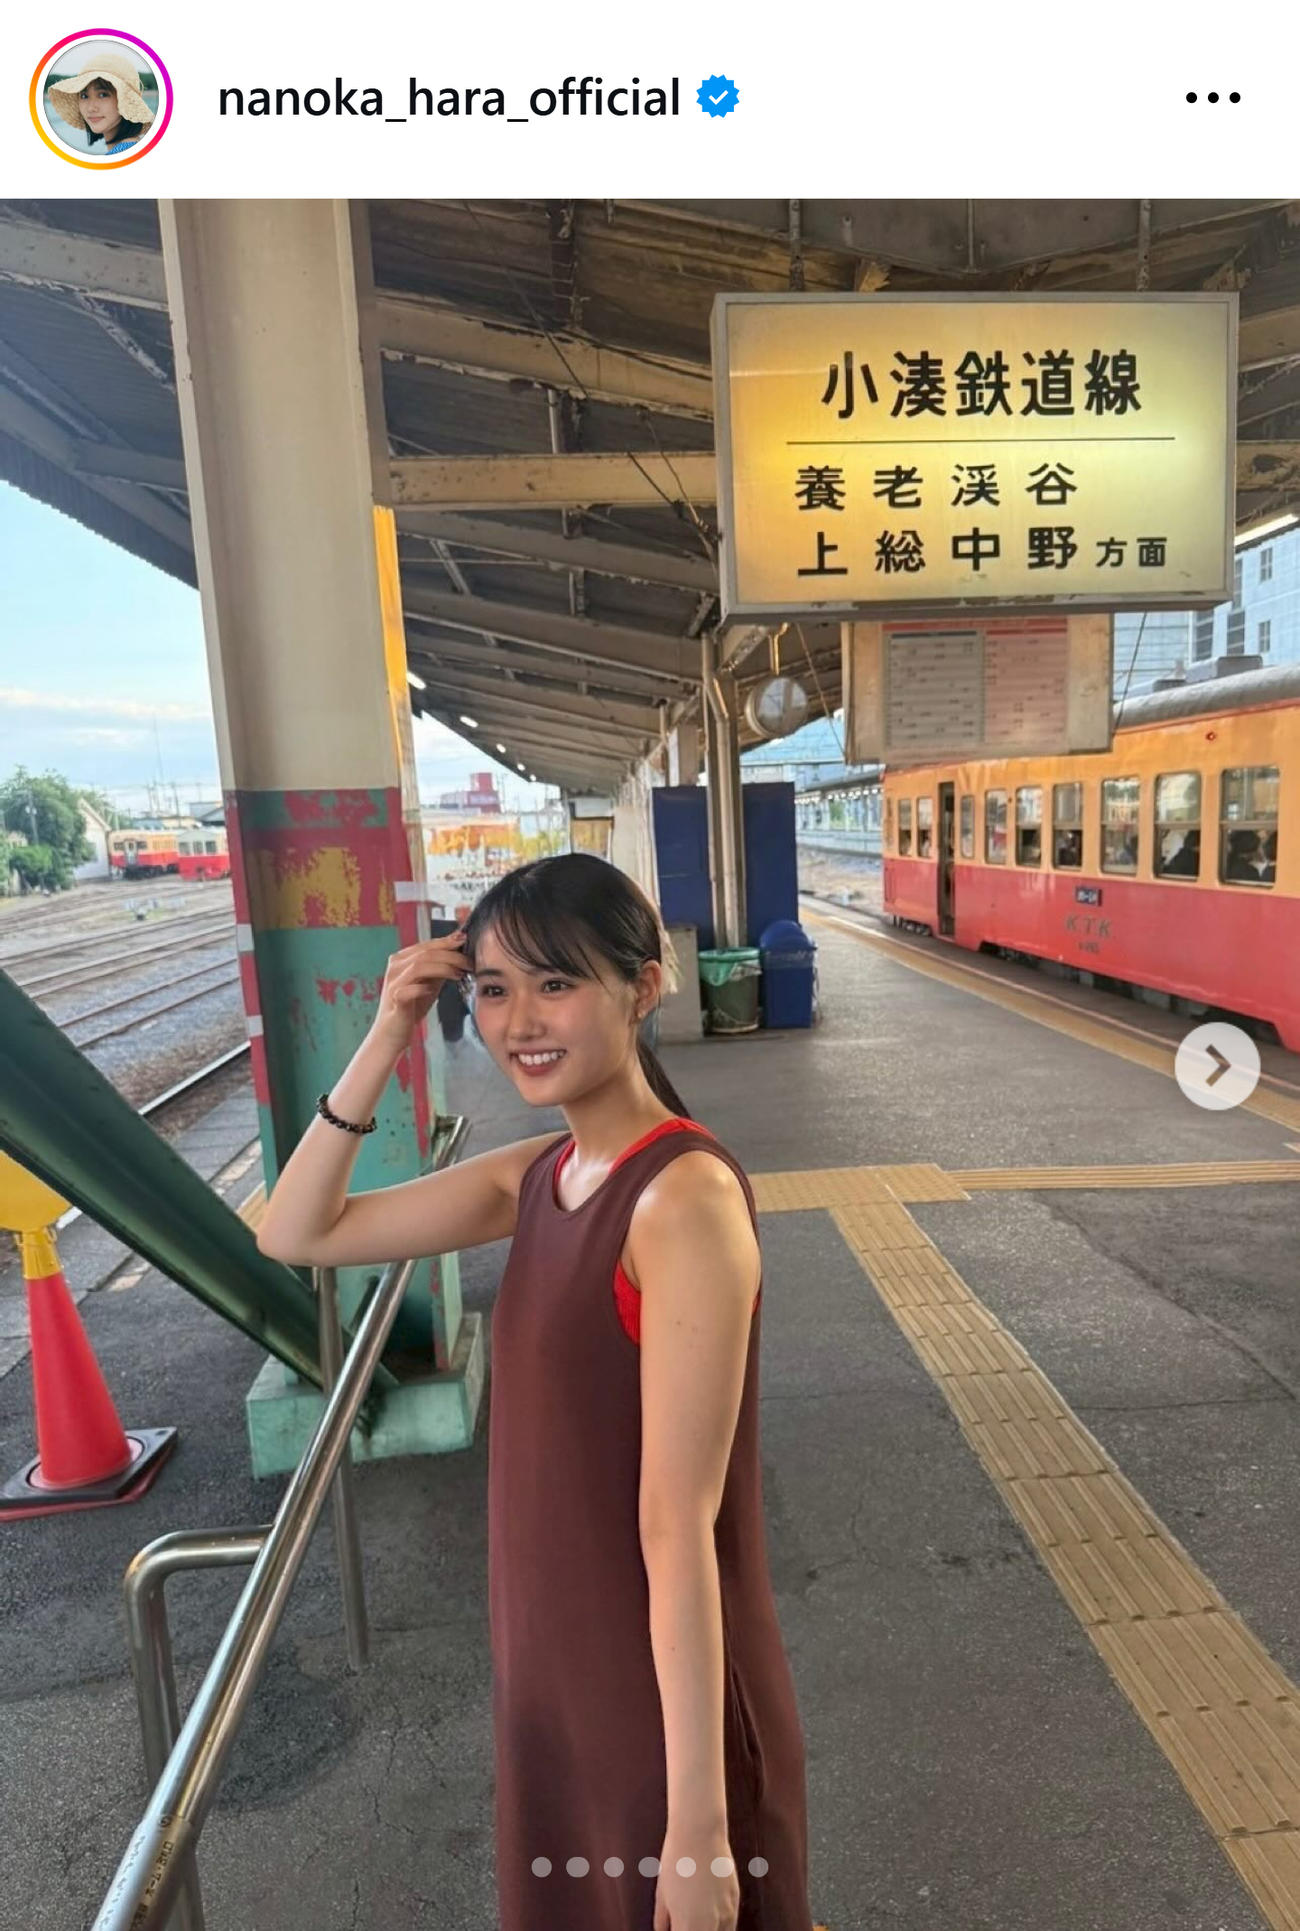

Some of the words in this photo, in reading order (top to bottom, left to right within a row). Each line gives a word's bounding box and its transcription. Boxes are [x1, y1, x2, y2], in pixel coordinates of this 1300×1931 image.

[821, 349, 1142, 419] 小湊鉄道線
[794, 462, 1078, 512] 養老渓谷
